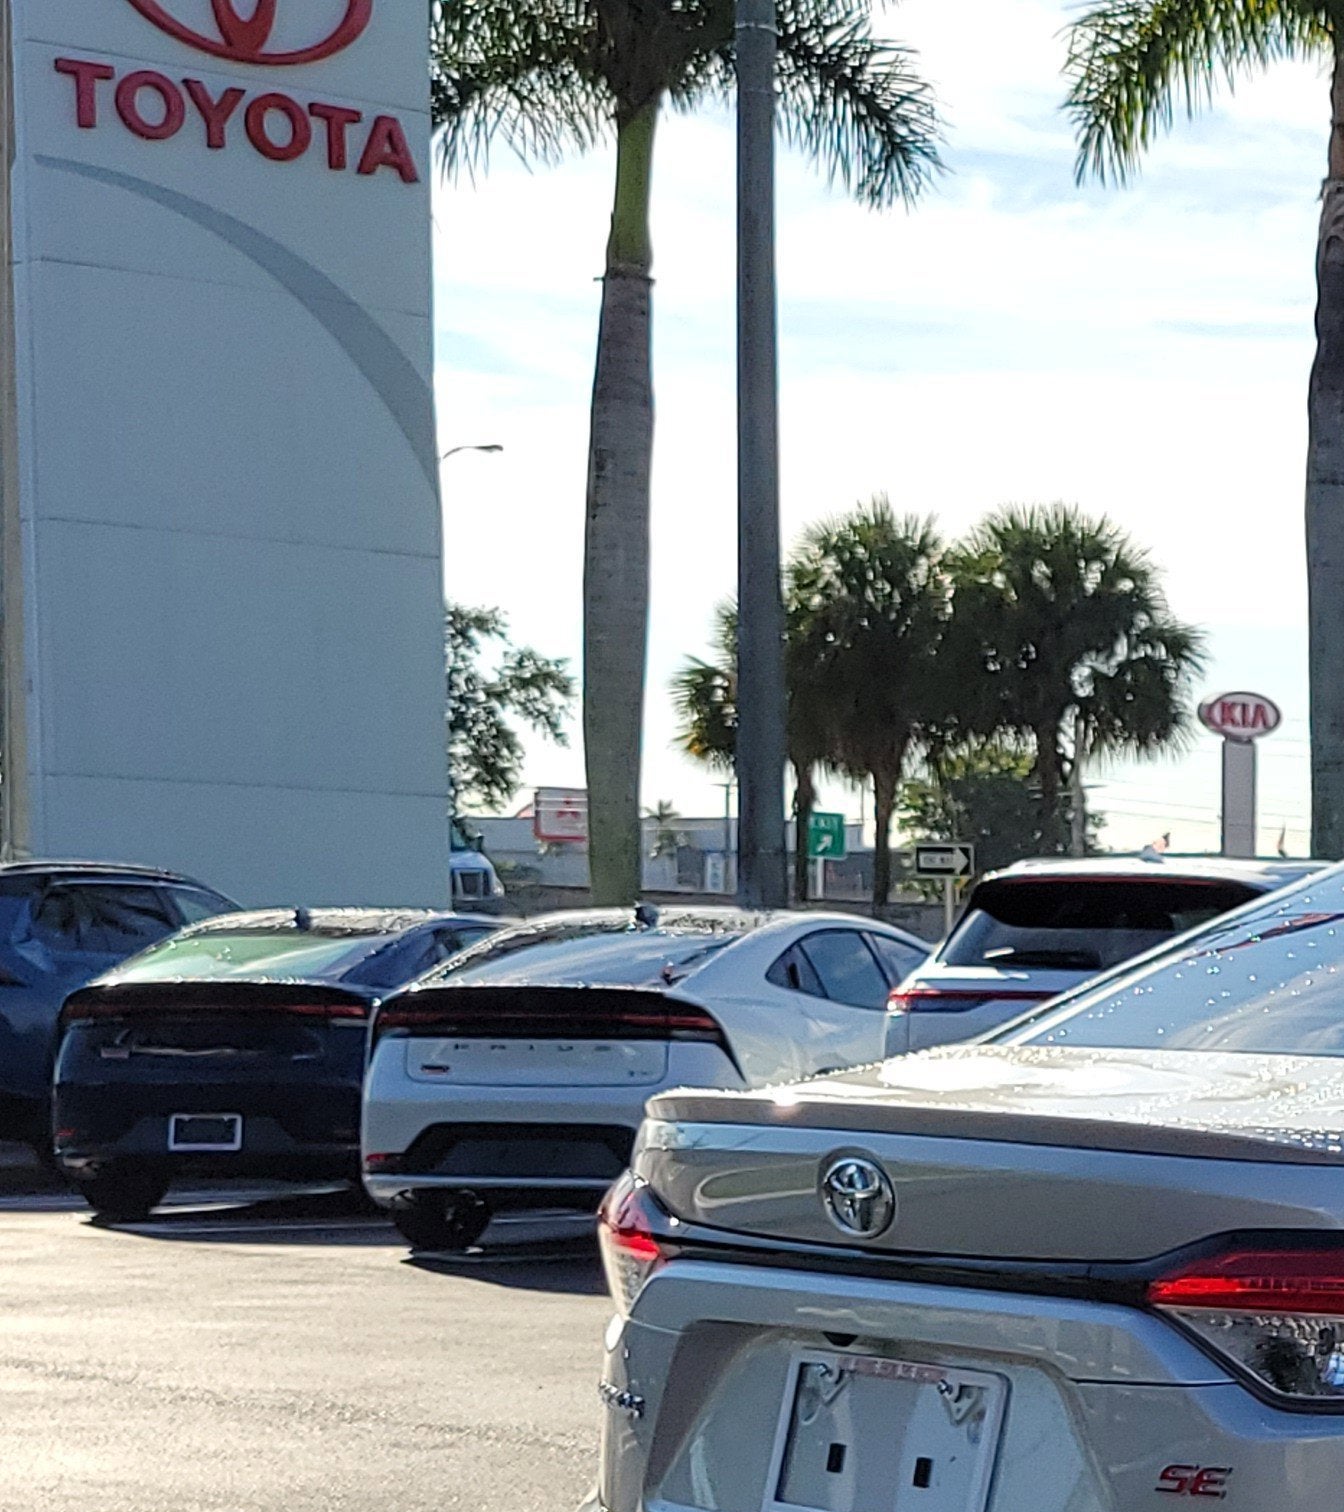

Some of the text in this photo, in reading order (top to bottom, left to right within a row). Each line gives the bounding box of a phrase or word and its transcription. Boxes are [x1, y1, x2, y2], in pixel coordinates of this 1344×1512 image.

[54, 57, 419, 184] TOYOTA
[1220, 701, 1268, 729] KIA
[1155, 1464, 1233, 1500] SE
